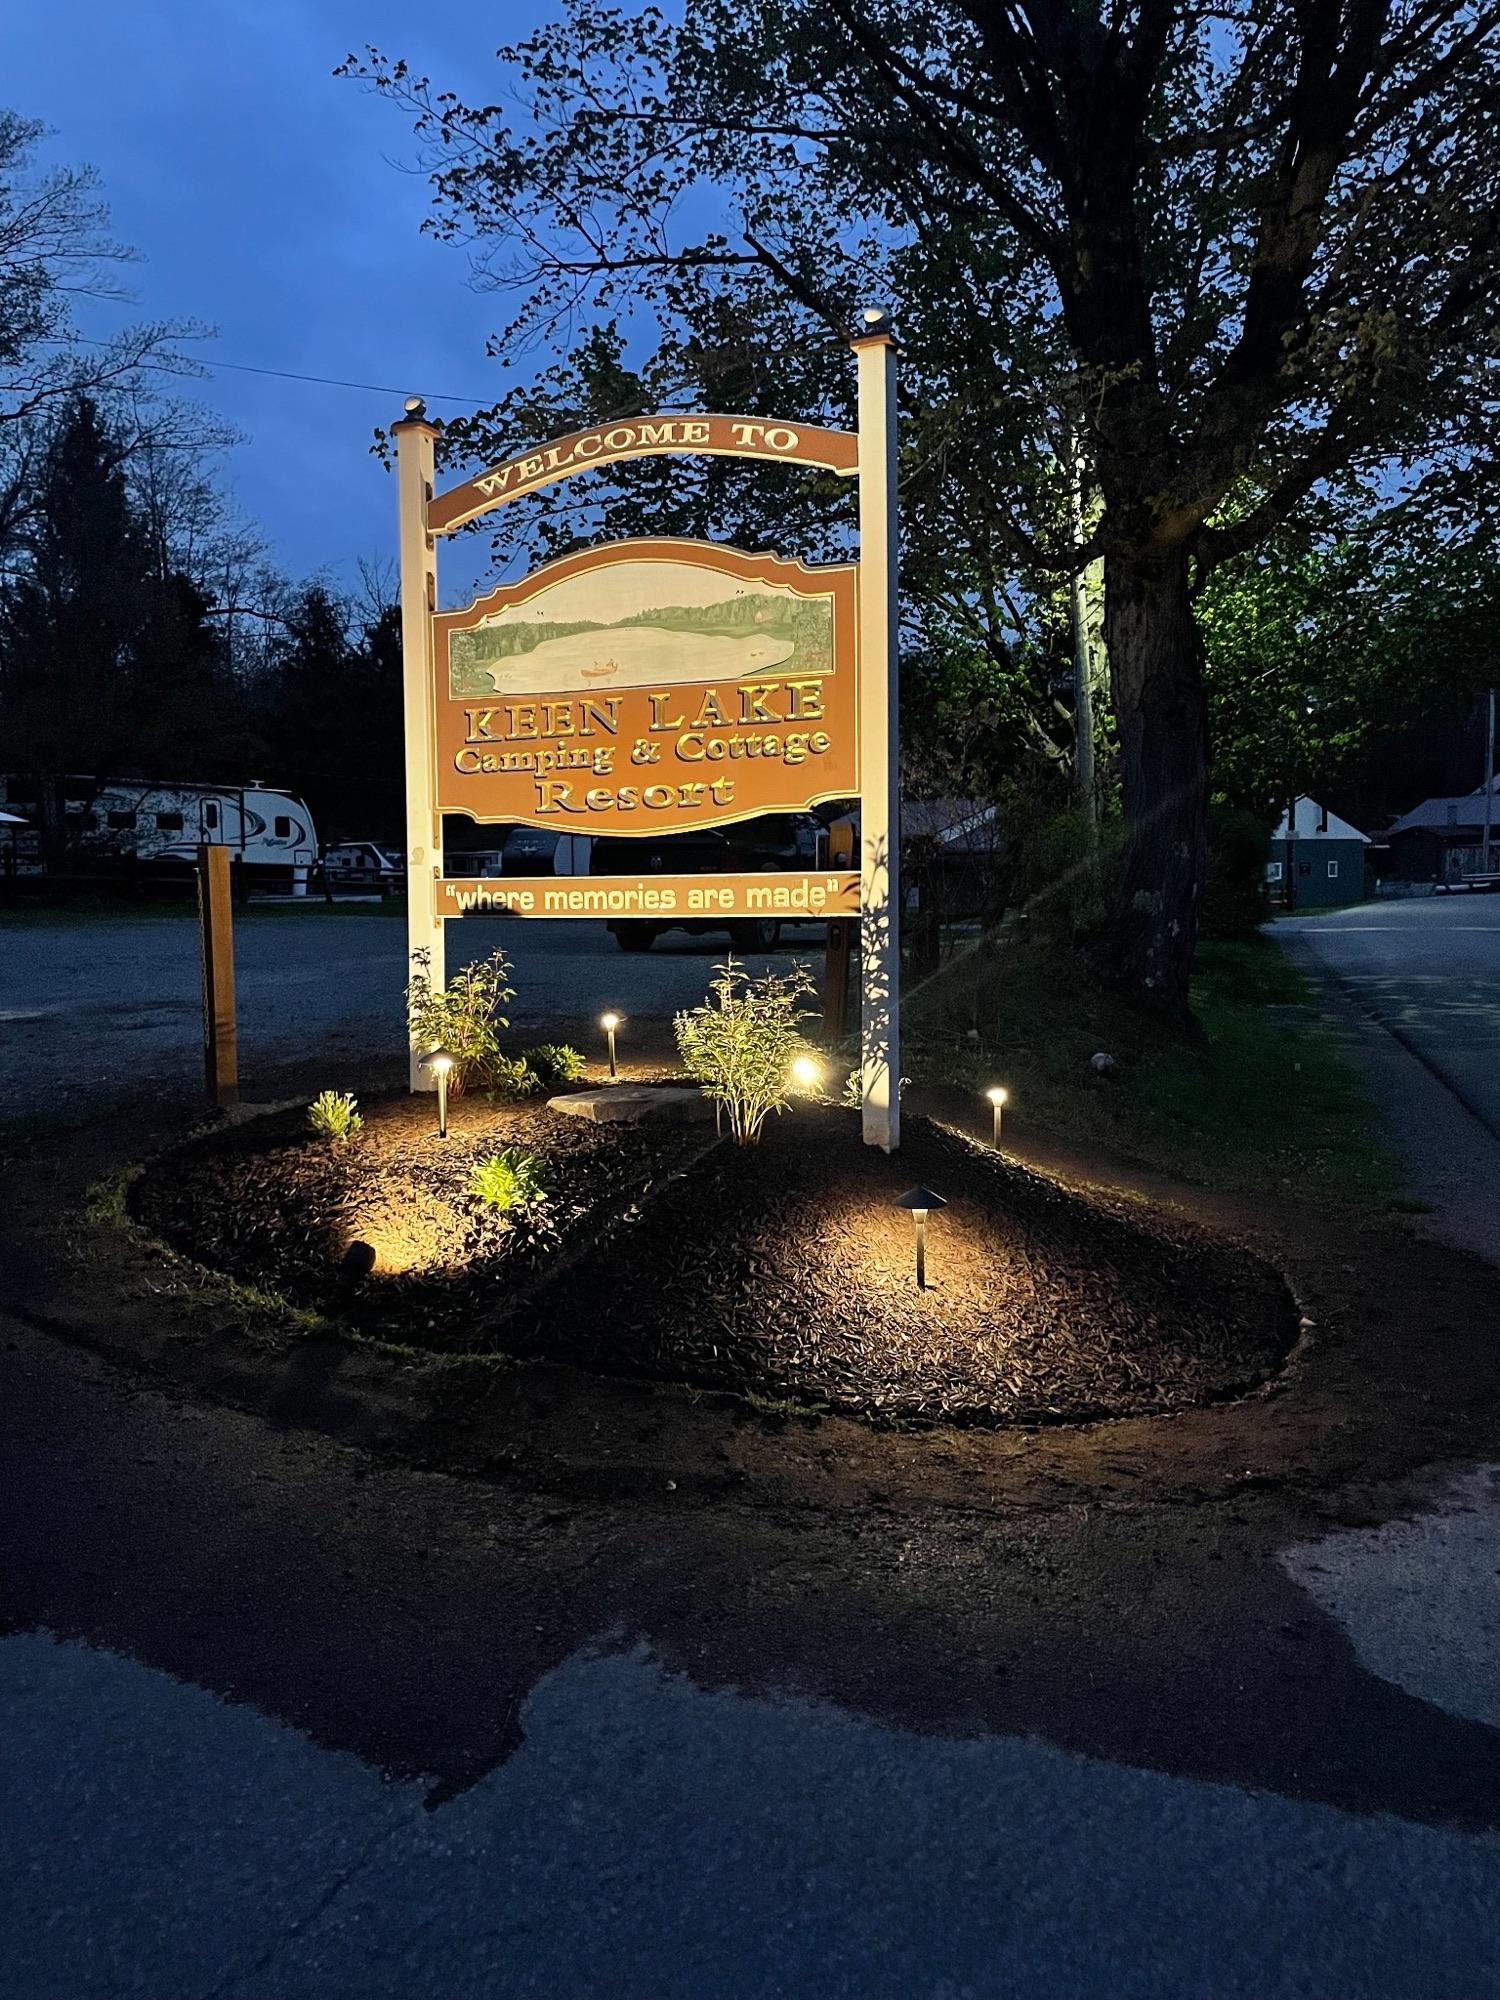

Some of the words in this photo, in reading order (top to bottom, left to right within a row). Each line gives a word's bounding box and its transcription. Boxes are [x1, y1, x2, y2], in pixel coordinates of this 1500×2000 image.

[473, 422, 710, 498] WELCOME
[731, 424, 799, 451] TO
[463, 696, 623, 744] KEEN
[648, 679, 827, 734] LAKE
[454, 740, 616, 778] Camping
[631, 739, 661, 766] &
[675, 727, 832, 765] Cottage
[534, 775, 736, 814] Resort
[544, 882, 677, 911] memories
[687, 886, 736, 909] are
